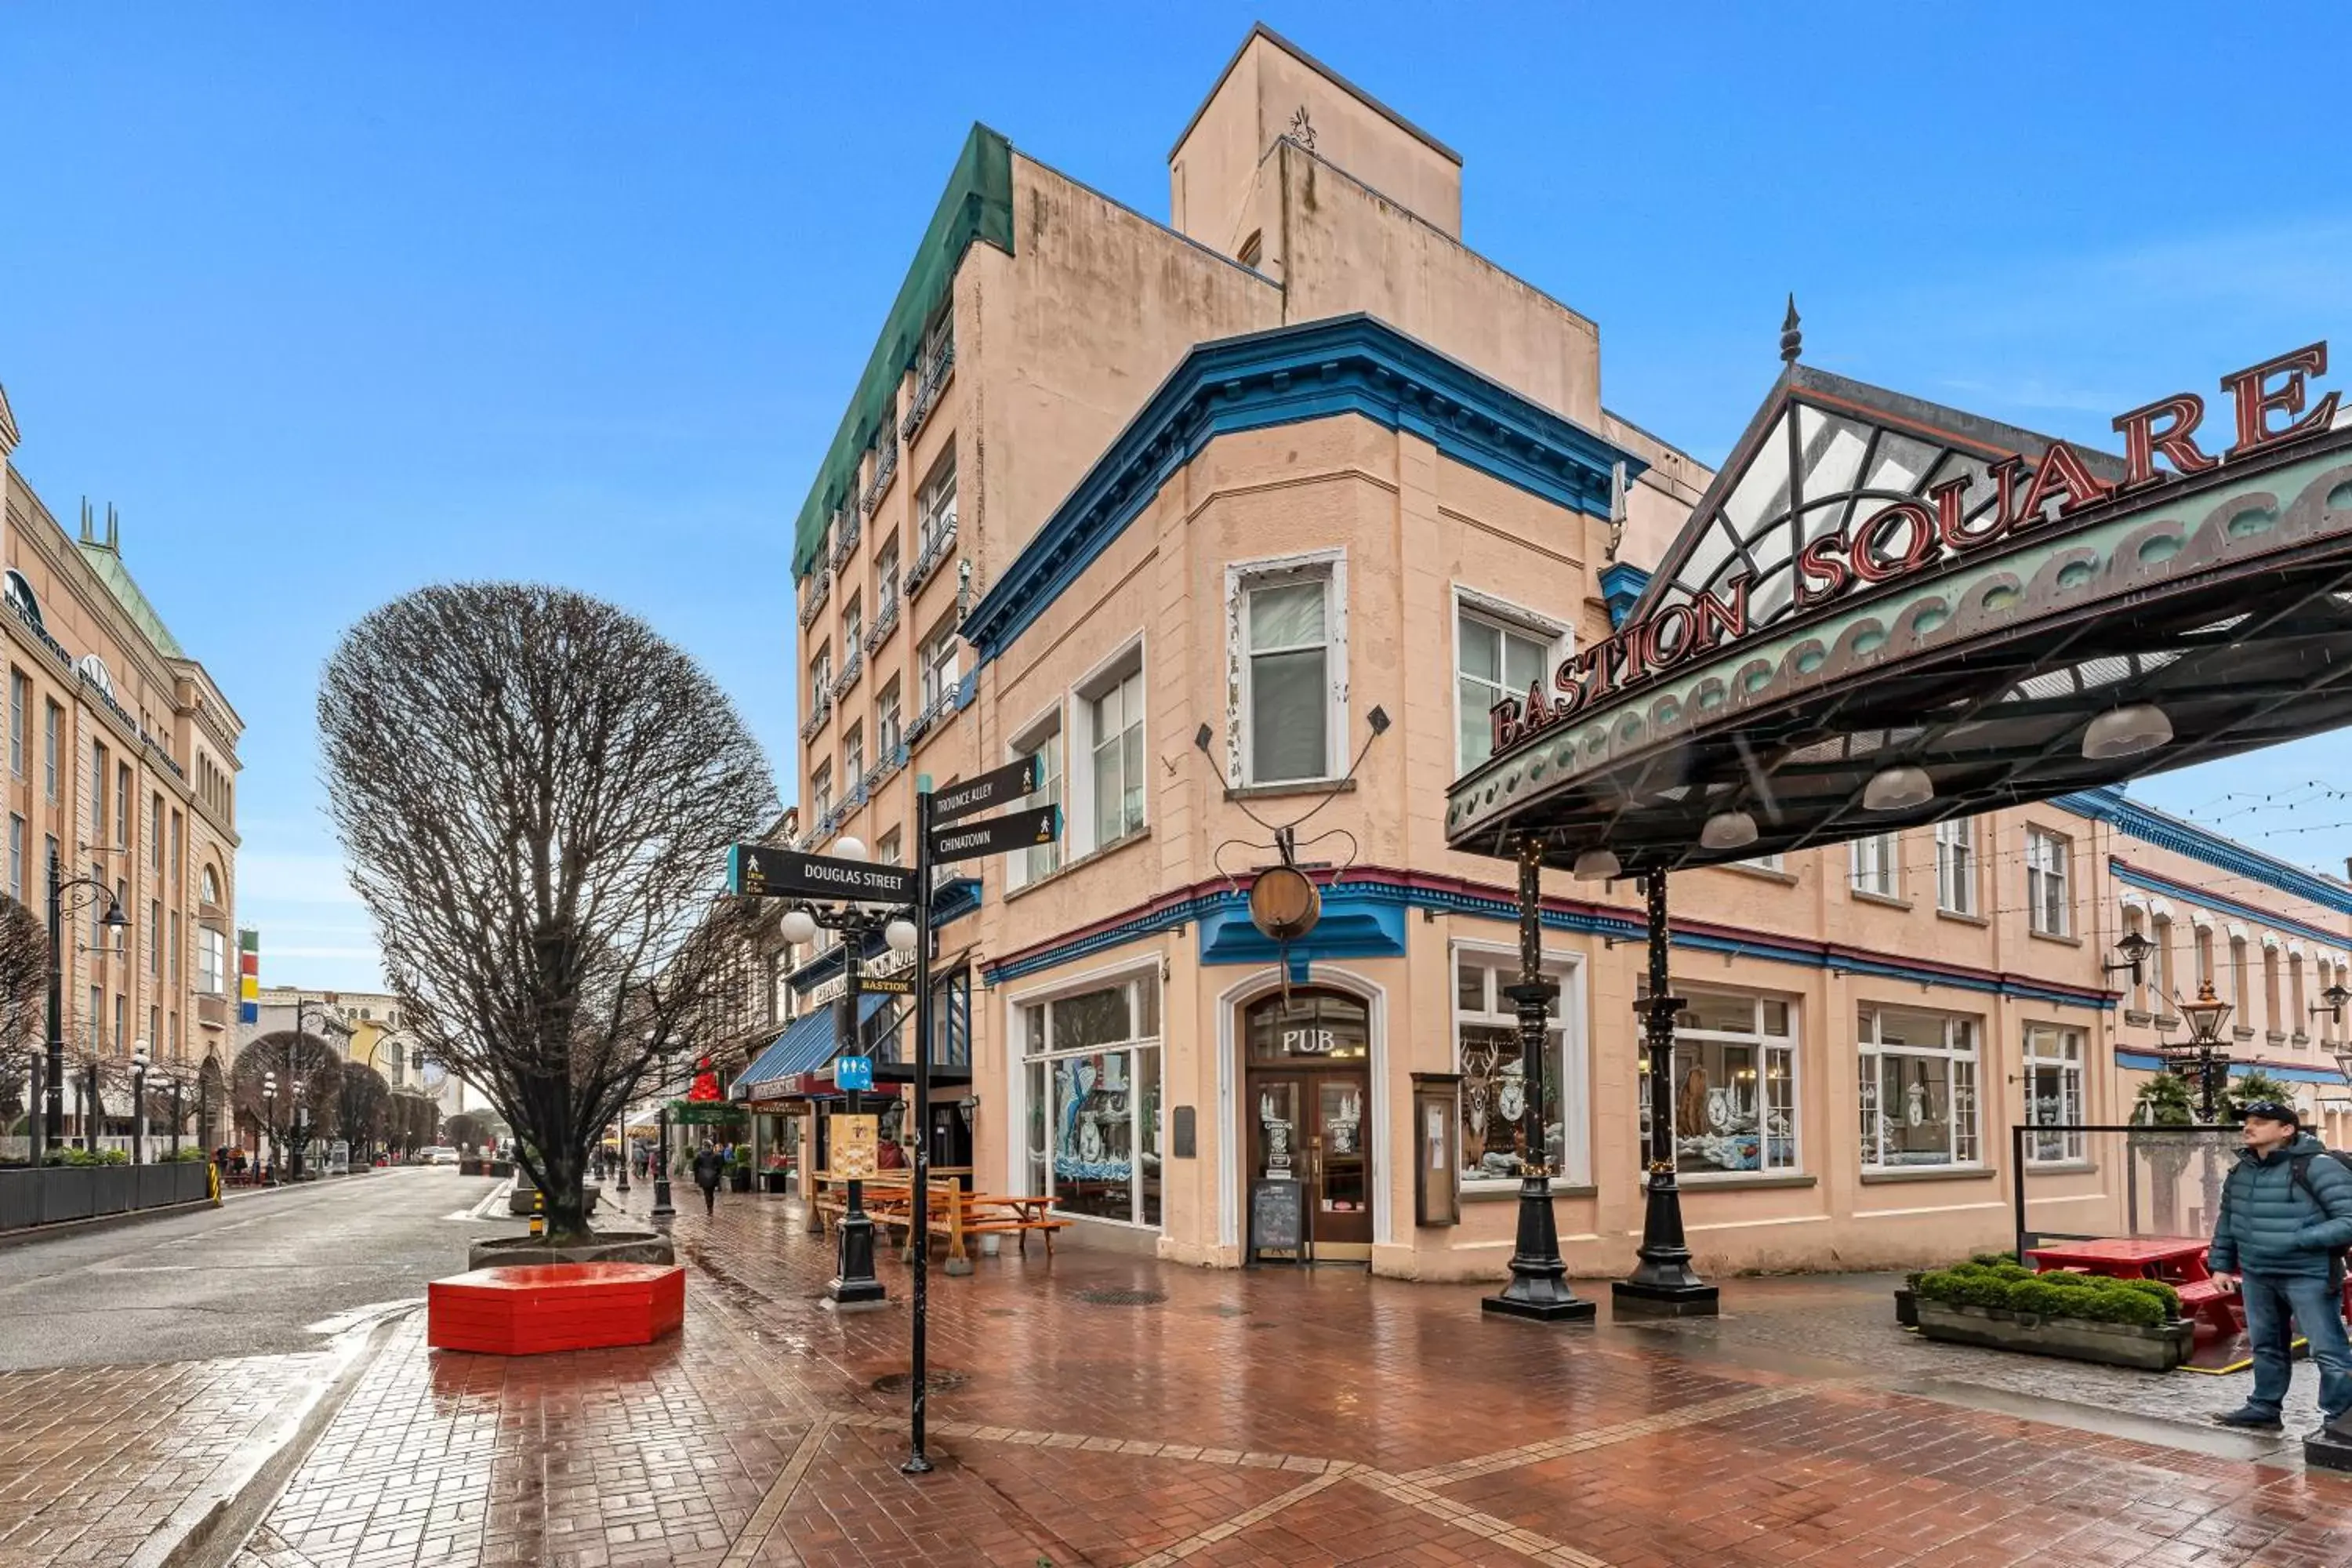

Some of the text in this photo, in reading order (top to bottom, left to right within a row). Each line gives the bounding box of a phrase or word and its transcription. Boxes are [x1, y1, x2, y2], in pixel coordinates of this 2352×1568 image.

[1490, 340, 2342, 757] BASTION SQUARE
[971, 783, 993, 801] ALLEY
[940, 829, 991, 852] CHINATOWN
[805, 863, 904, 891] DOUGLAS STREET
[862, 980, 909, 993] BASTION
[1282, 1029, 1335, 1052] PUB
